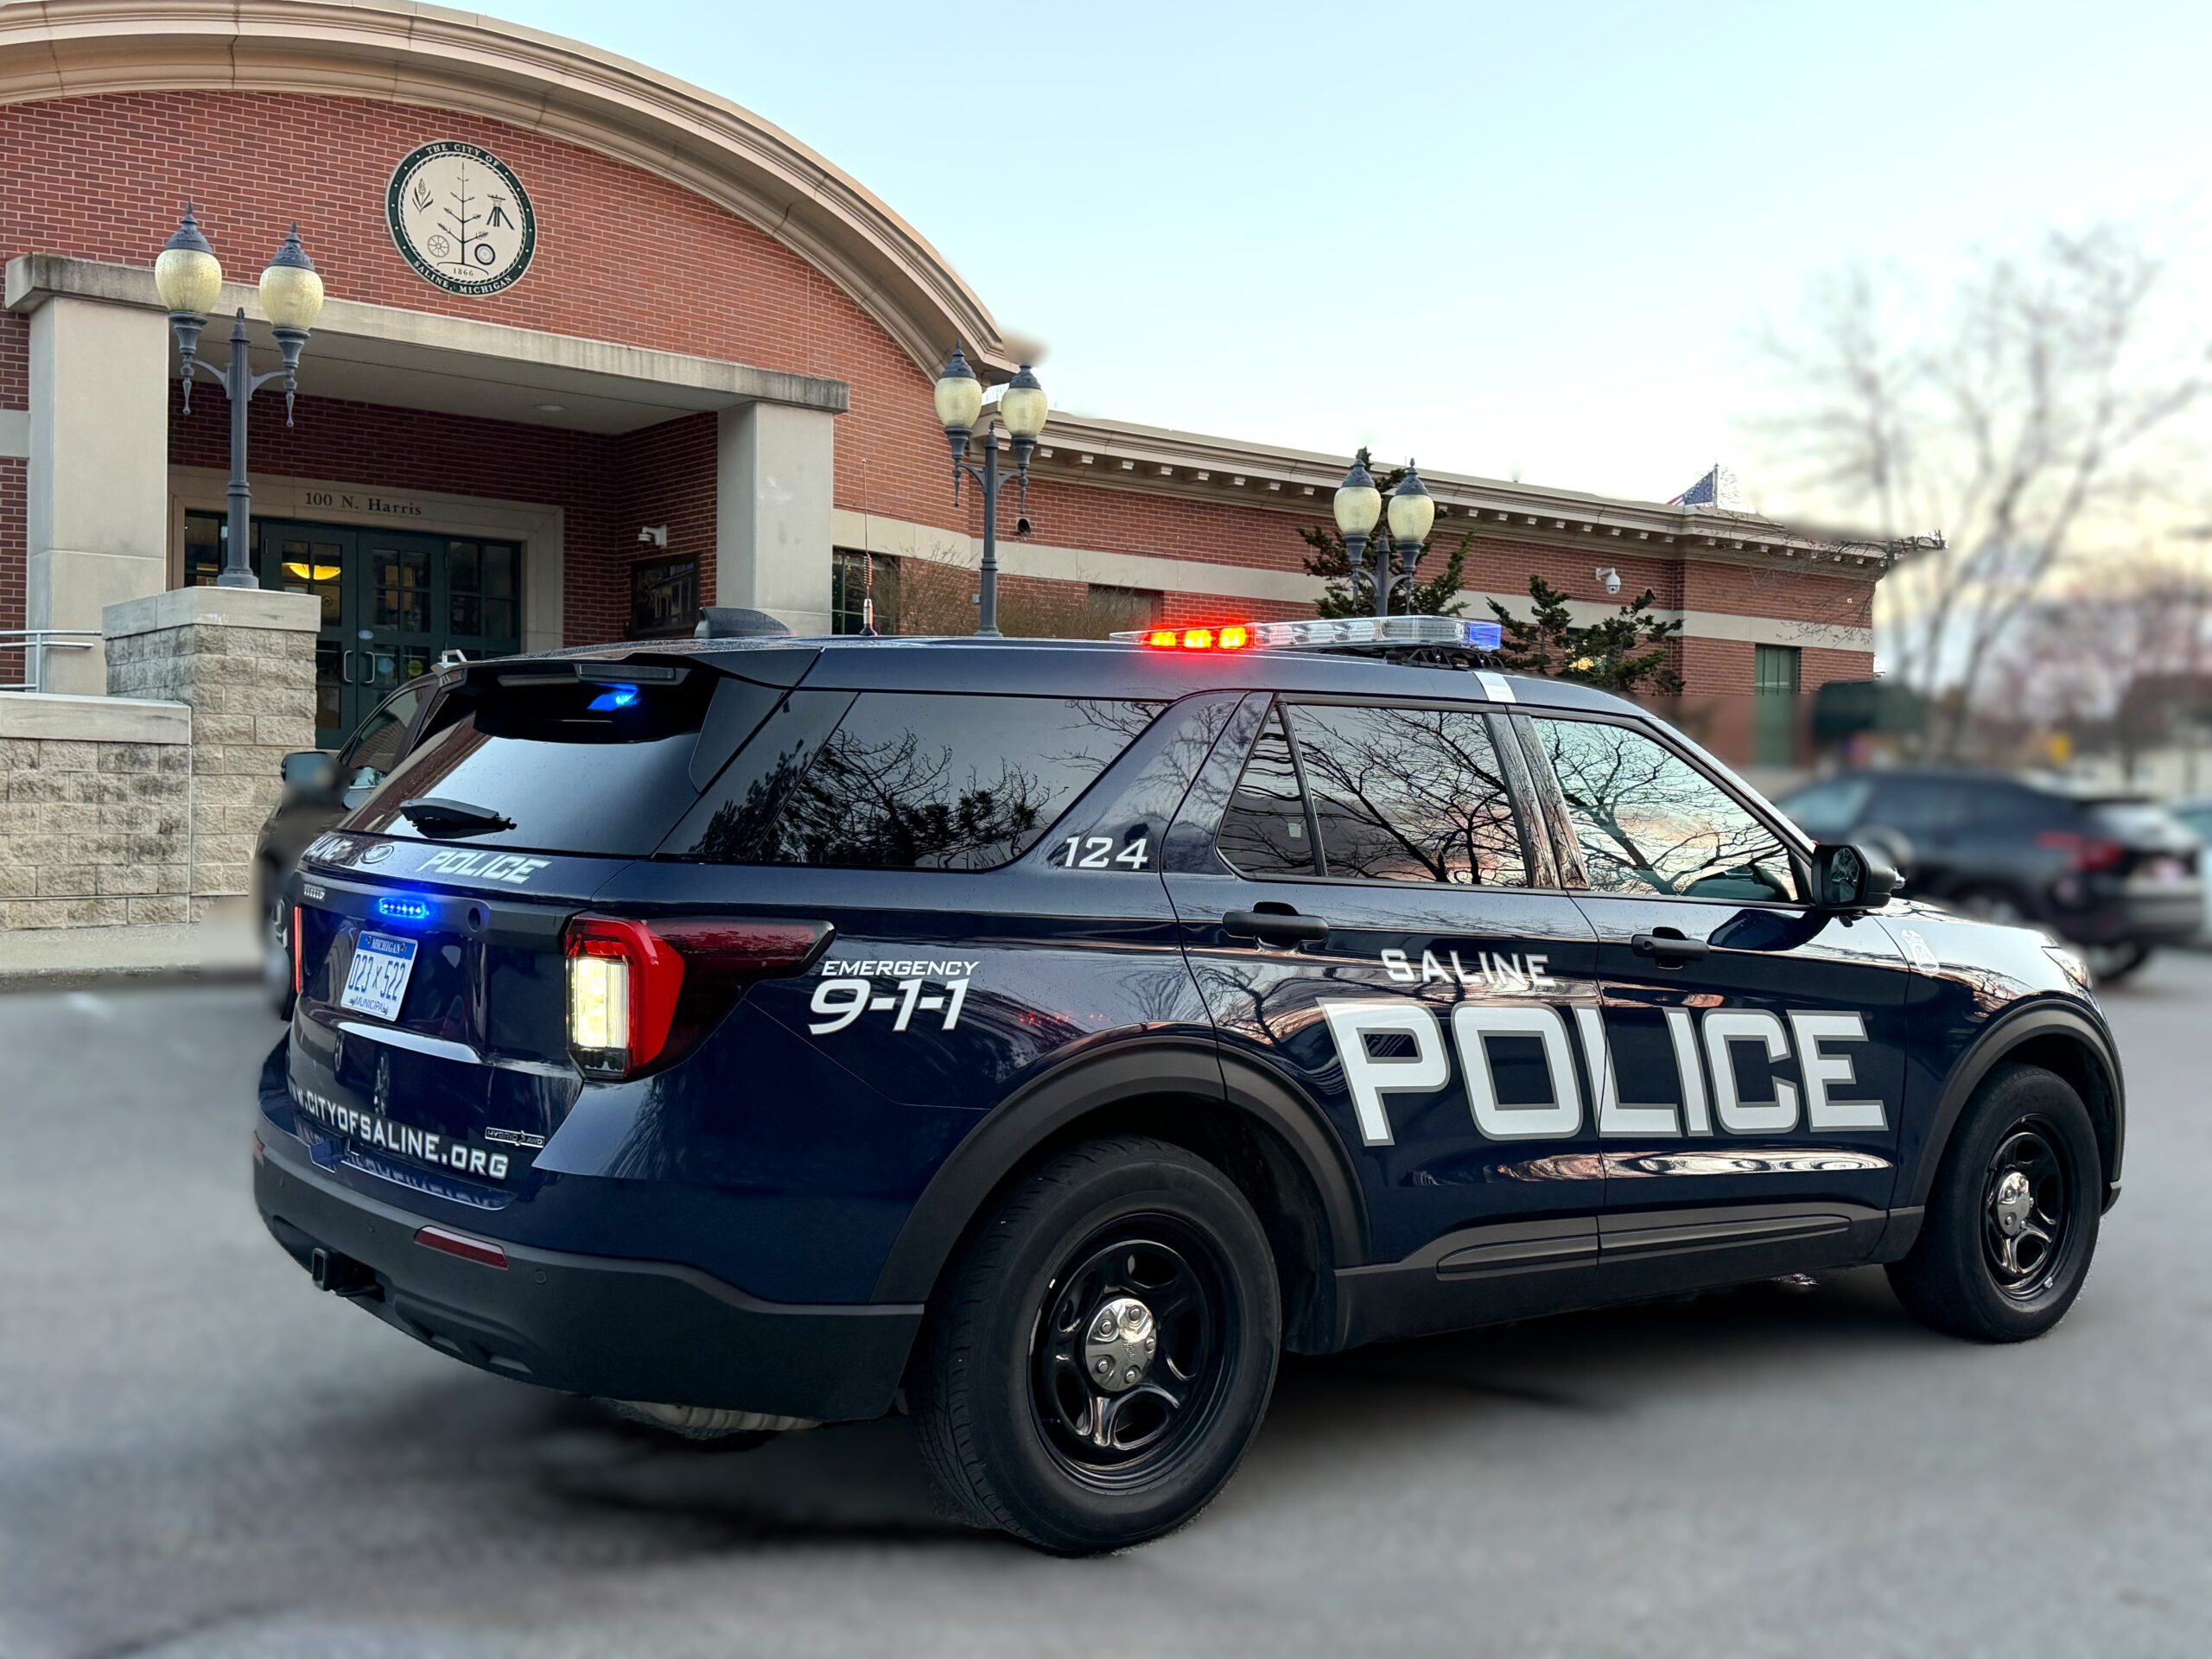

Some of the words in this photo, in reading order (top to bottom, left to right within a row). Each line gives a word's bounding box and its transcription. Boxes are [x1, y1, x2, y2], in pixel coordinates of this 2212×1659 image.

[425, 144, 448, 156] THE
[454, 143, 481, 156] CITY
[485, 155, 500, 168] OF
[413, 261, 454, 292] SALINE,
[459, 275, 512, 295] MICHIGAN
[453, 267, 474, 276] 1866
[305, 493, 333, 506] 100
[341, 495, 359, 510] N.
[367, 498, 422, 515] Harris
[415, 850, 552, 885] POLICE
[1065, 836, 1148, 869] 124
[371, 938, 401, 954] MICHIGAN
[821, 960, 981, 976] EMERGENCY
[1381, 949, 1554, 987] SALINE
[808, 977, 969, 1035] 9-1-1
[1315, 997, 1889, 1147] POLICE
